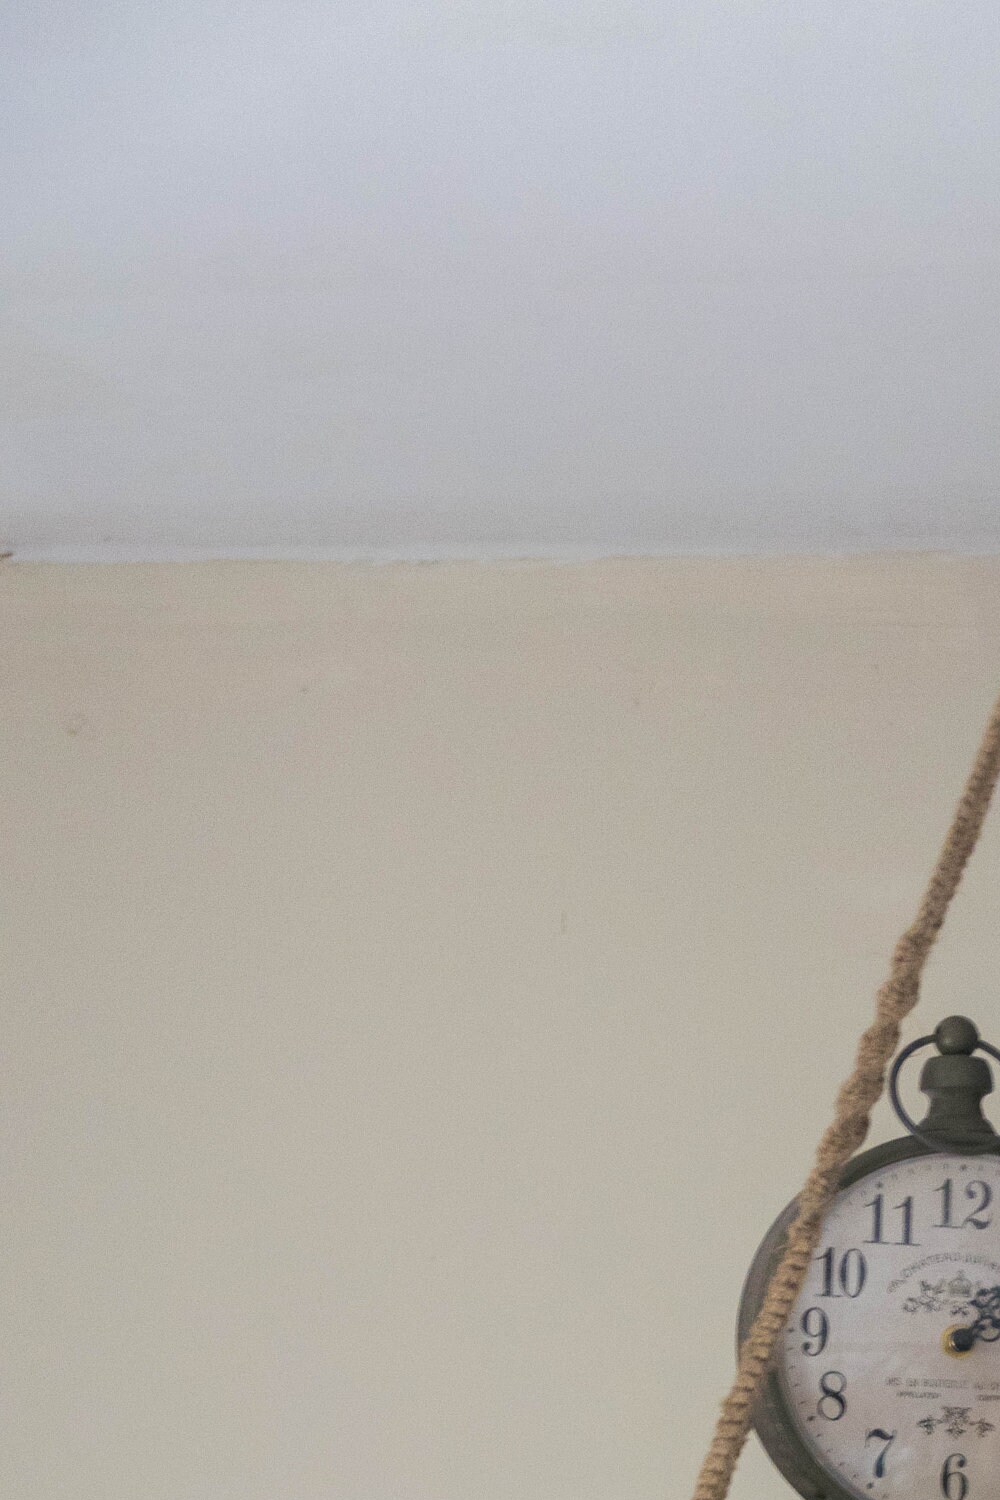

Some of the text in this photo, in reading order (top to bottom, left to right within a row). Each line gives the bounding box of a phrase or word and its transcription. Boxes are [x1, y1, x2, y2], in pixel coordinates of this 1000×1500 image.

[862, 1193, 922, 1247] 11
[932, 1178, 993, 1230] 12
[814, 1246, 868, 1299] 10
[801, 1307, 830, 1357] 9
[817, 1371, 847, 1421] 8
[865, 1428, 898, 1478] 7
